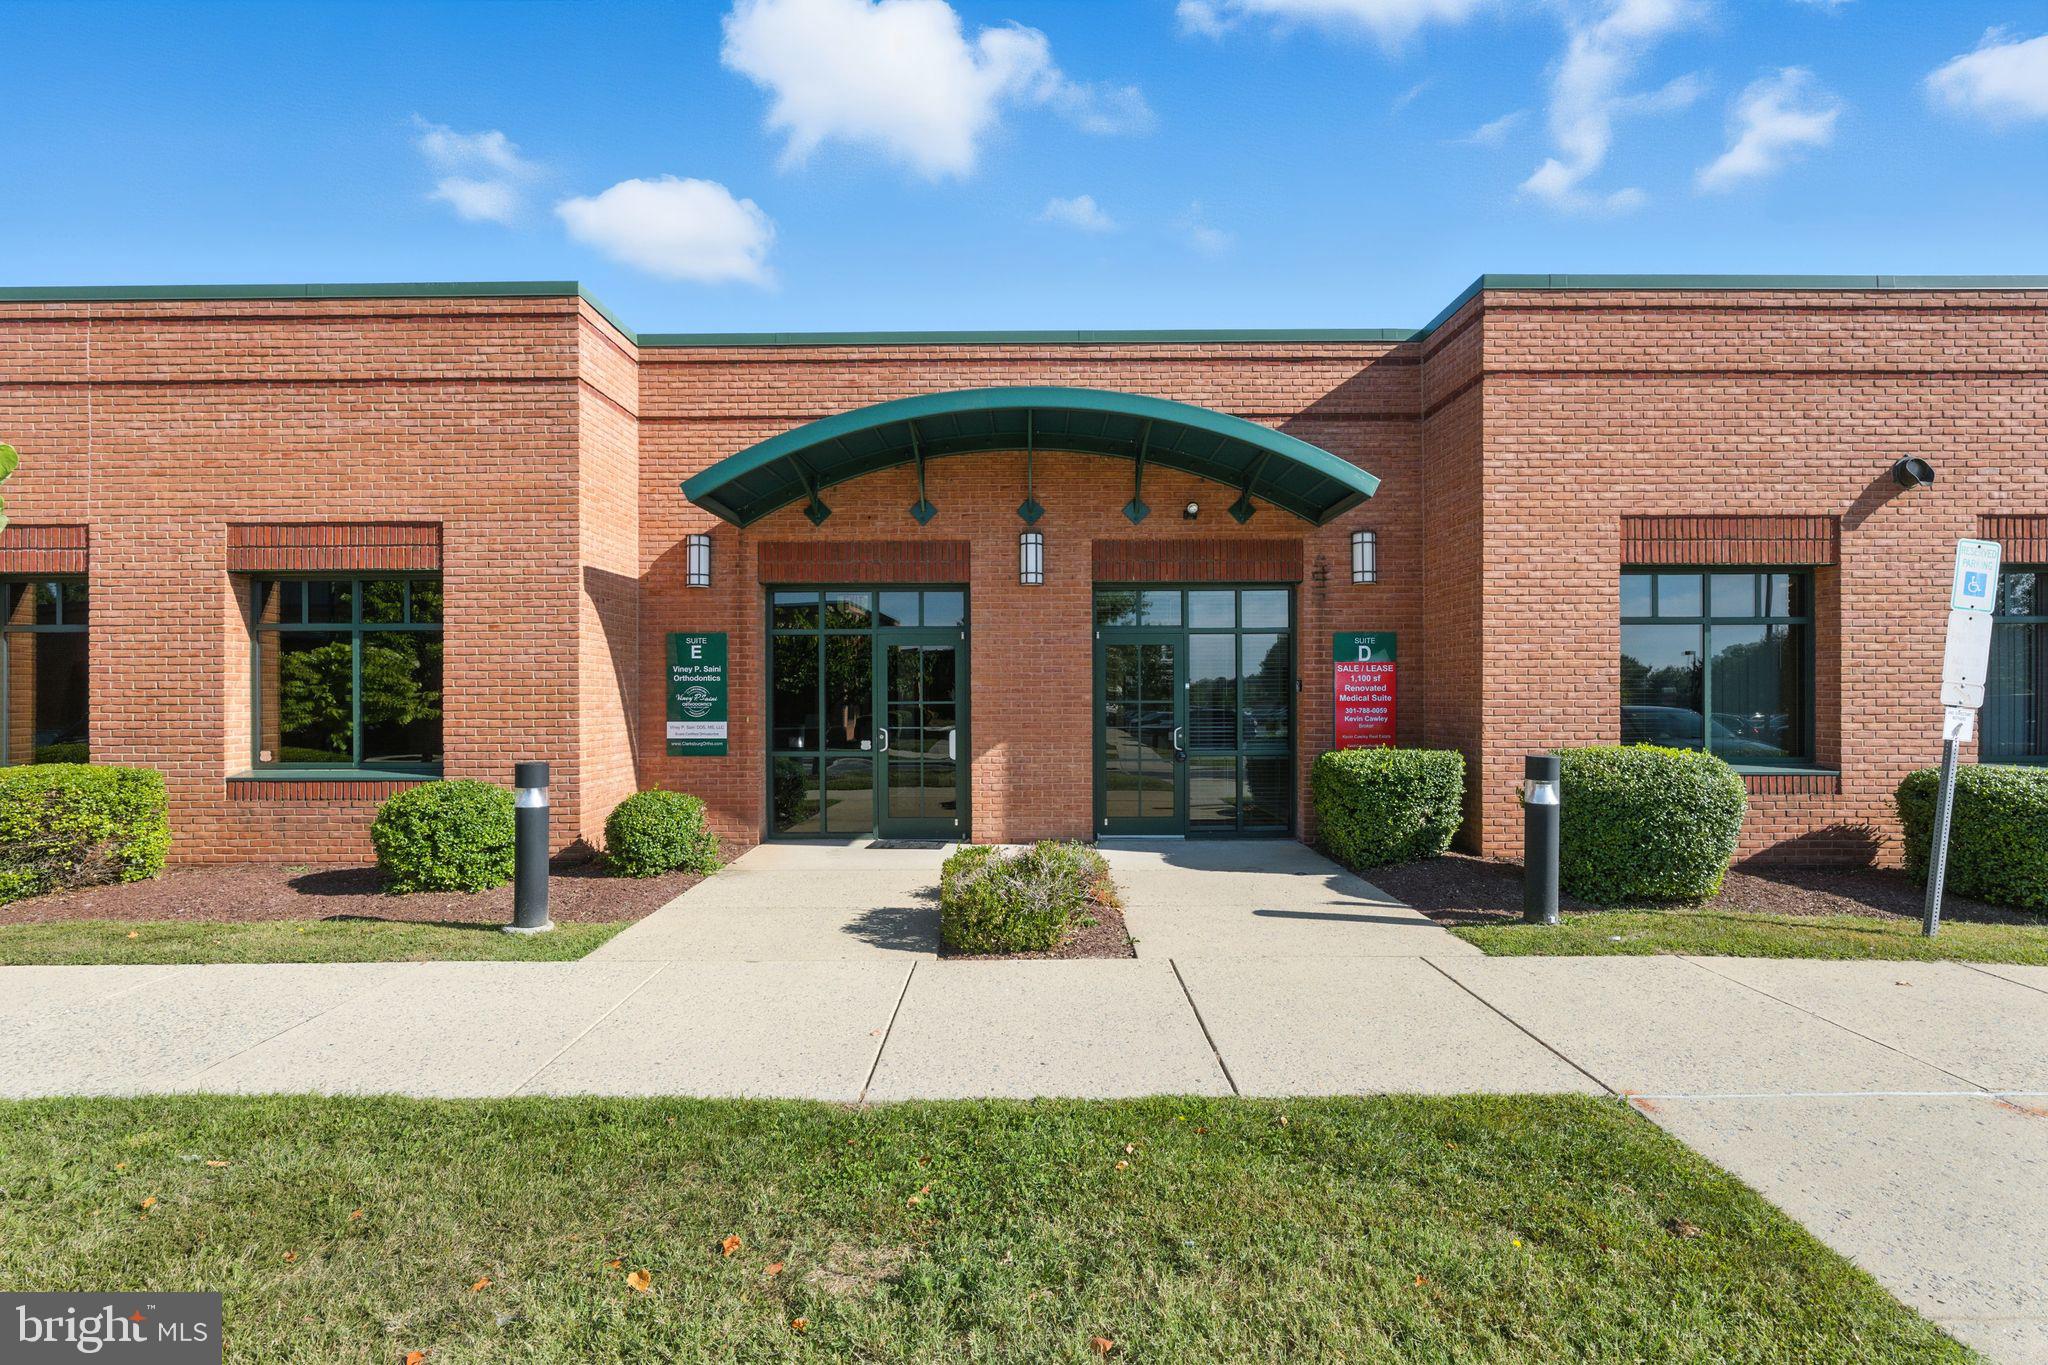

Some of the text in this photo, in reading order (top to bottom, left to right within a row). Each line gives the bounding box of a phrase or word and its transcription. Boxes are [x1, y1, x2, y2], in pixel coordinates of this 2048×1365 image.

[691, 645, 702, 659] E
[1358, 645, 1372, 661] D
[672, 665, 721, 673] Viney P. Saini
[1337, 664, 1360, 672] SALE
[1366, 664, 1394, 672] LEASE
[673, 674, 721, 682] Orthodontics
[1350, 674, 1381, 683] 1,100 sf
[1344, 684, 1387, 692] Renovated
[1339, 694, 1392, 702] Medical Suite
[1364, 715, 1388, 724] Cawley
